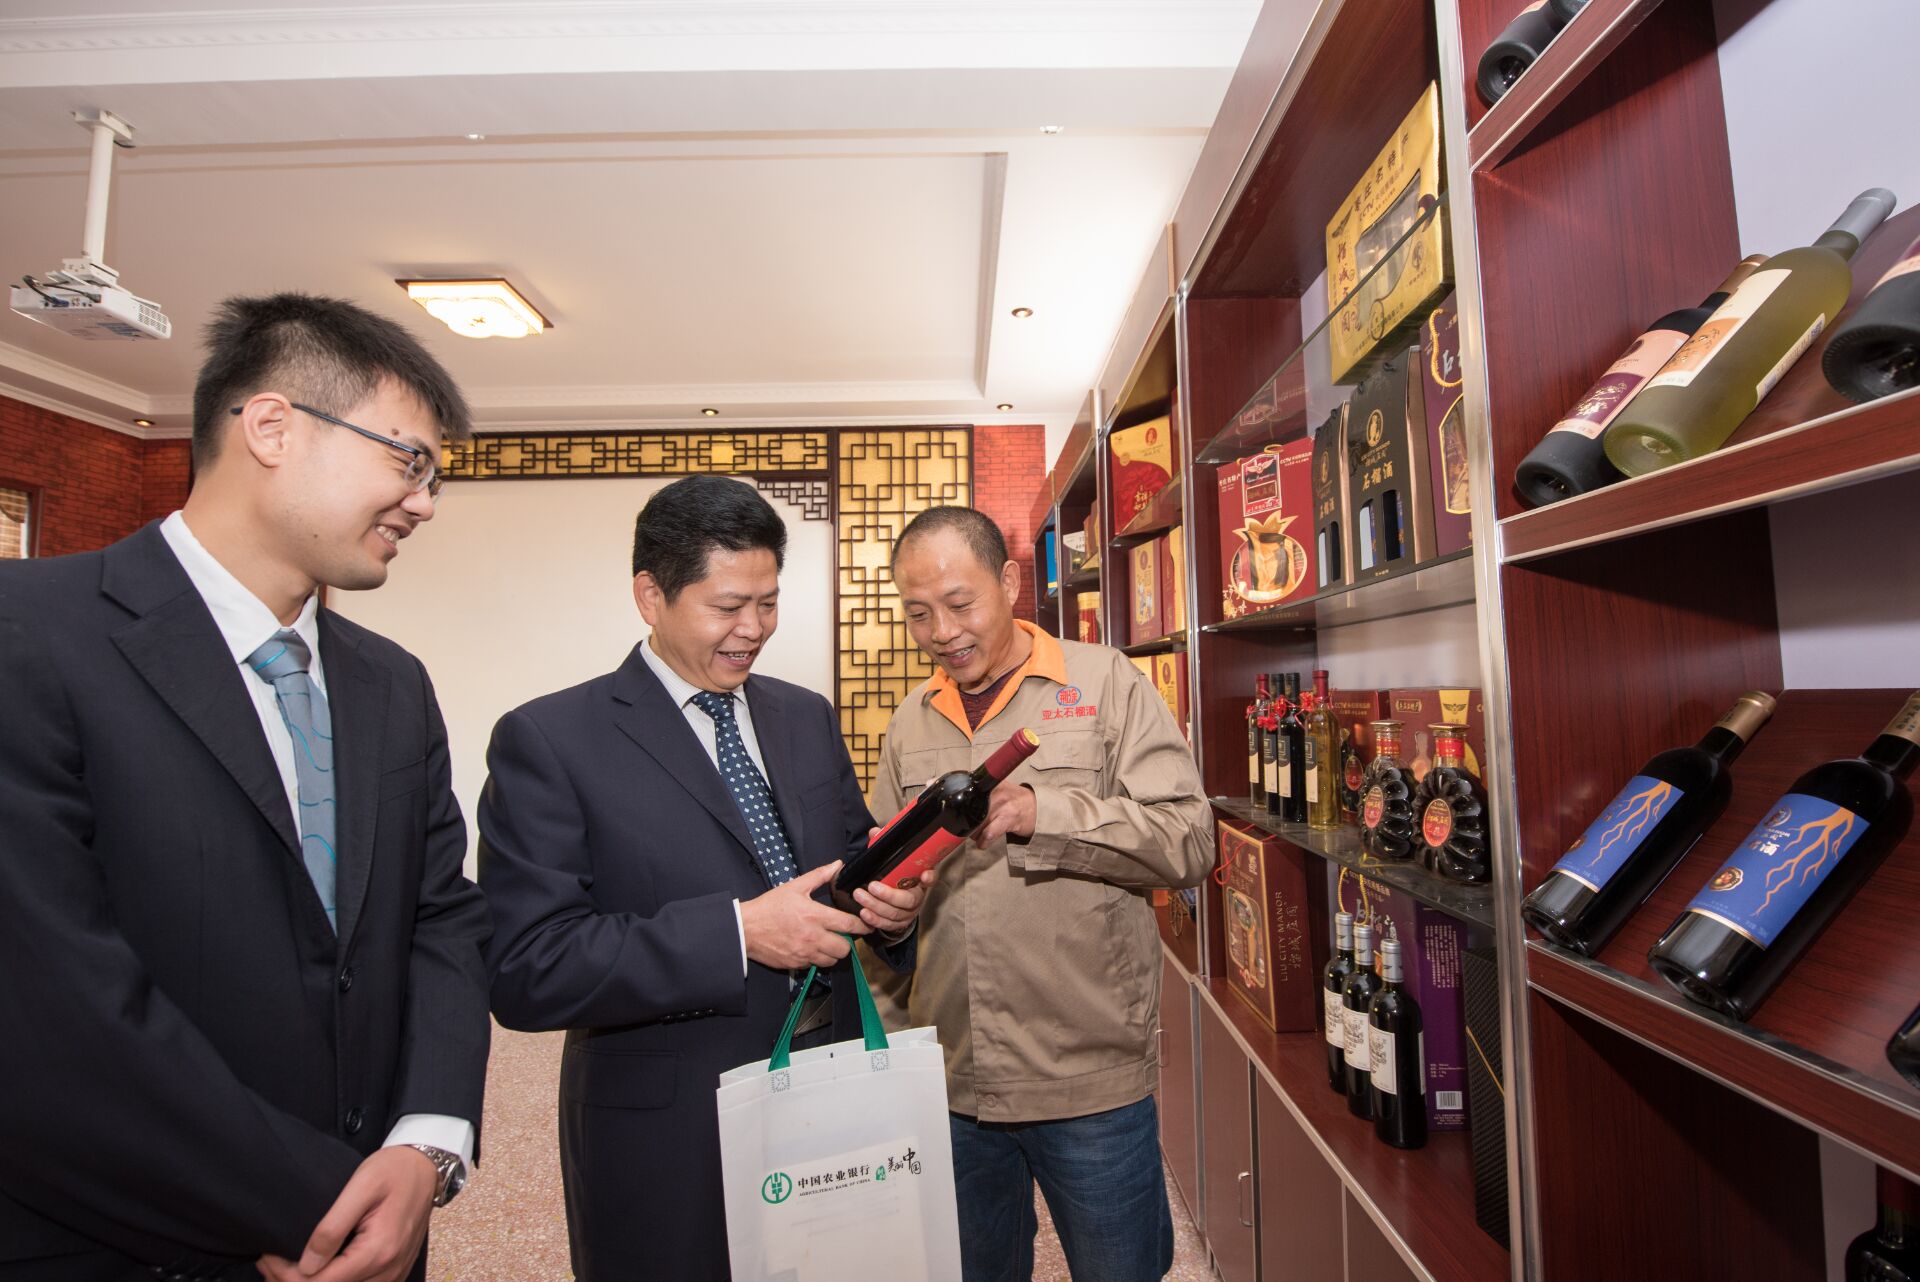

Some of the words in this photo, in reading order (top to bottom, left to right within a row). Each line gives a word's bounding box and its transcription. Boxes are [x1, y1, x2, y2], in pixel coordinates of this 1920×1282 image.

[1362, 461, 1393, 491] 石榴酒
[1042, 705, 1097, 720] 亚太石榴酒
[1275, 891, 1285, 933] MANOR
[1278, 936, 1287, 961] CITY
[1280, 964, 1288, 981] LIU
[798, 1164, 870, 1188] 中国农业银行
[856, 1178, 871, 1186] CHINA
